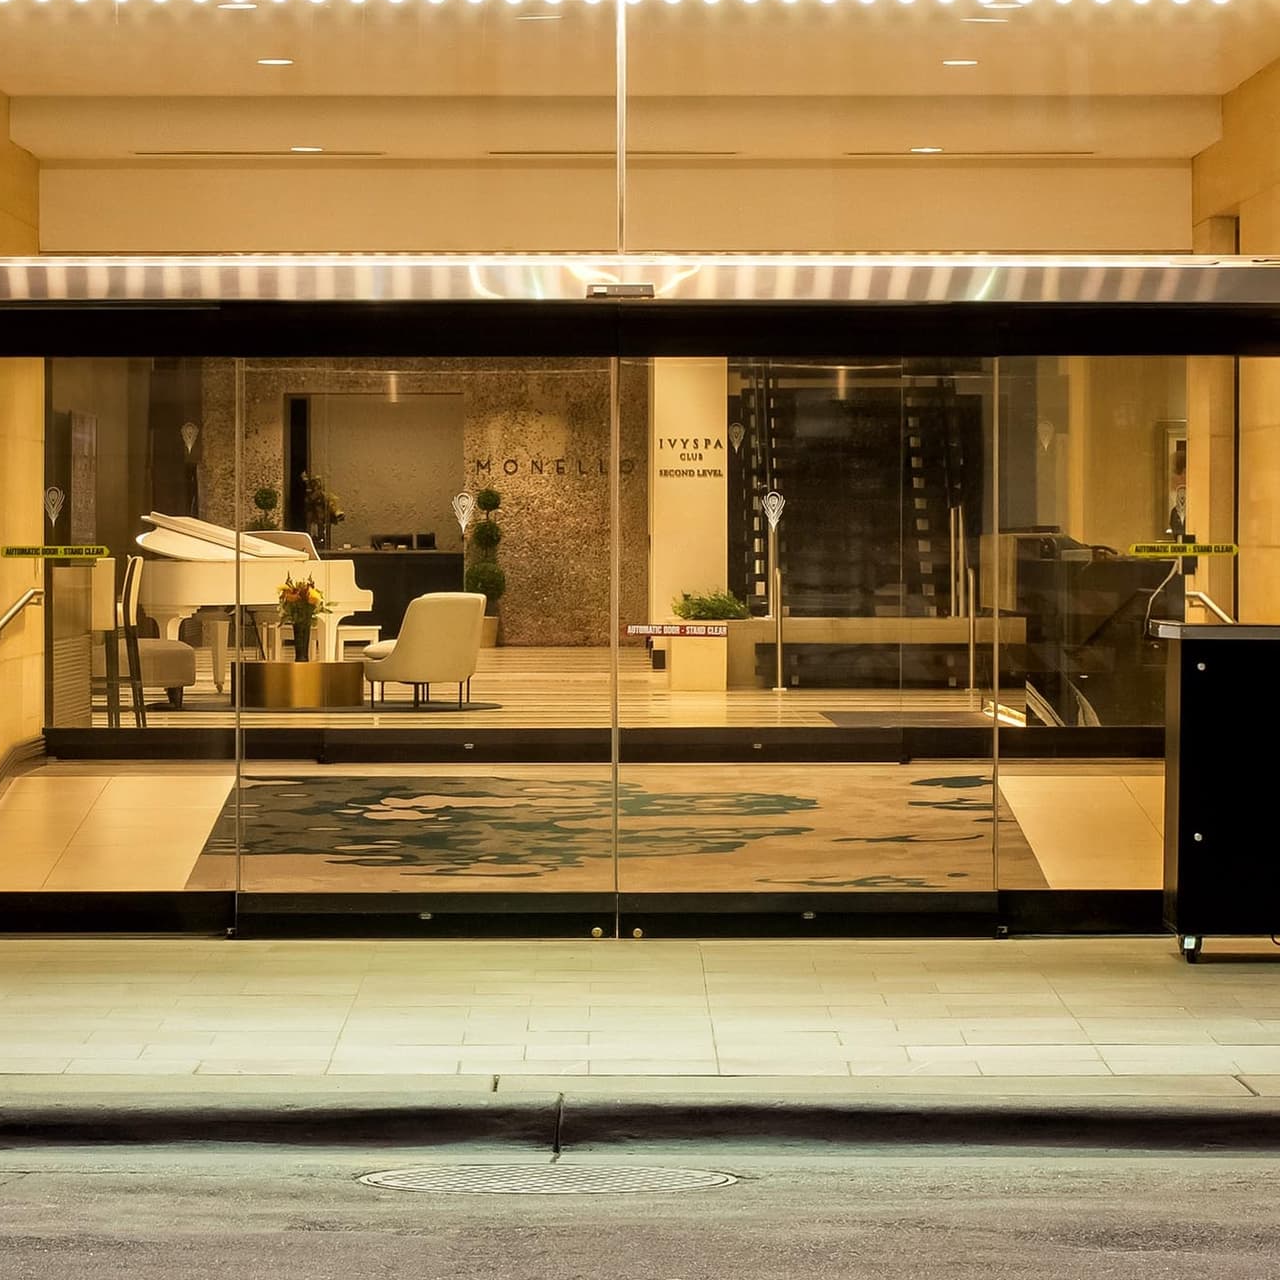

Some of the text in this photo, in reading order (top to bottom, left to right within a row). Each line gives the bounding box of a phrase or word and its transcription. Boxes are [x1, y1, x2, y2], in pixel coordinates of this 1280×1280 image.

[679, 452, 703, 462] CLUB
[476, 458, 634, 475] MONELLO
[658, 469, 724, 478] SECOND LEVEL
[1214, 544, 1234, 553] CLEAR
[626, 625, 662, 634] AUTOMATIC
[663, 625, 680, 634] DOOR
[686, 625, 706, 635] STAND
[707, 625, 727, 635] CLEAR
